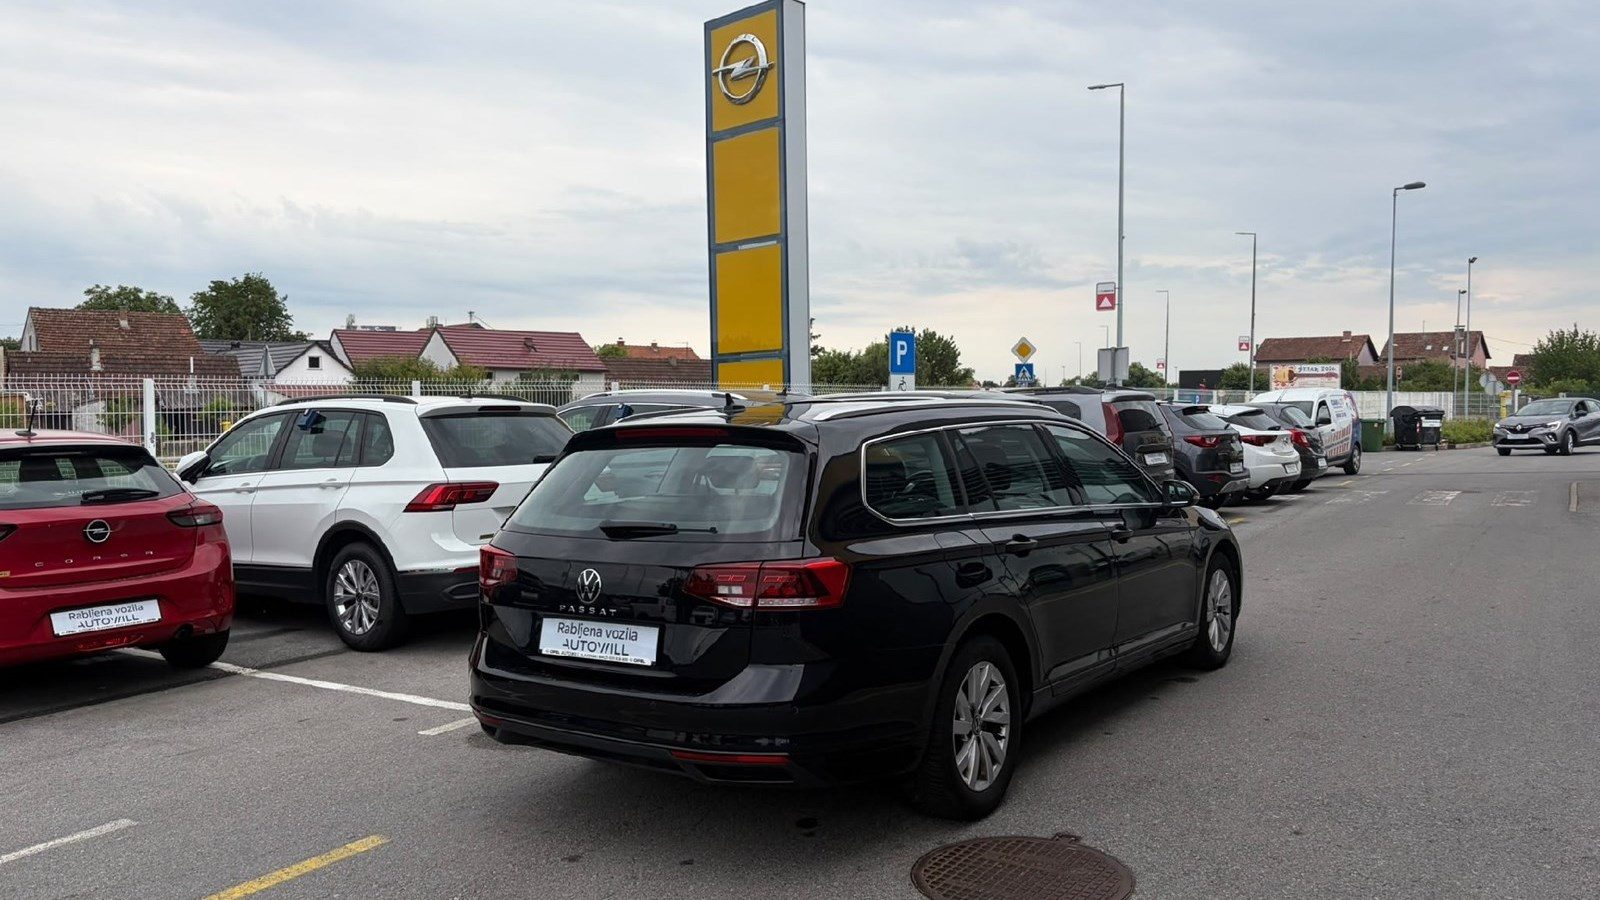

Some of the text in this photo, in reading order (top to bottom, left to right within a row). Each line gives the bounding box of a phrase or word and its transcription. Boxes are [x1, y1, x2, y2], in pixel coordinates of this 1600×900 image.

[896, 340, 908, 366] P
[68, 607, 113, 621] Rabljena
[115, 603, 144, 615] vozila
[560, 604, 617, 616] PASSAT
[77, 613, 140, 628] AUTOWILL
[557, 621, 638, 641] Rabljena vozila
[562, 638, 630, 657] AUTOWILL
